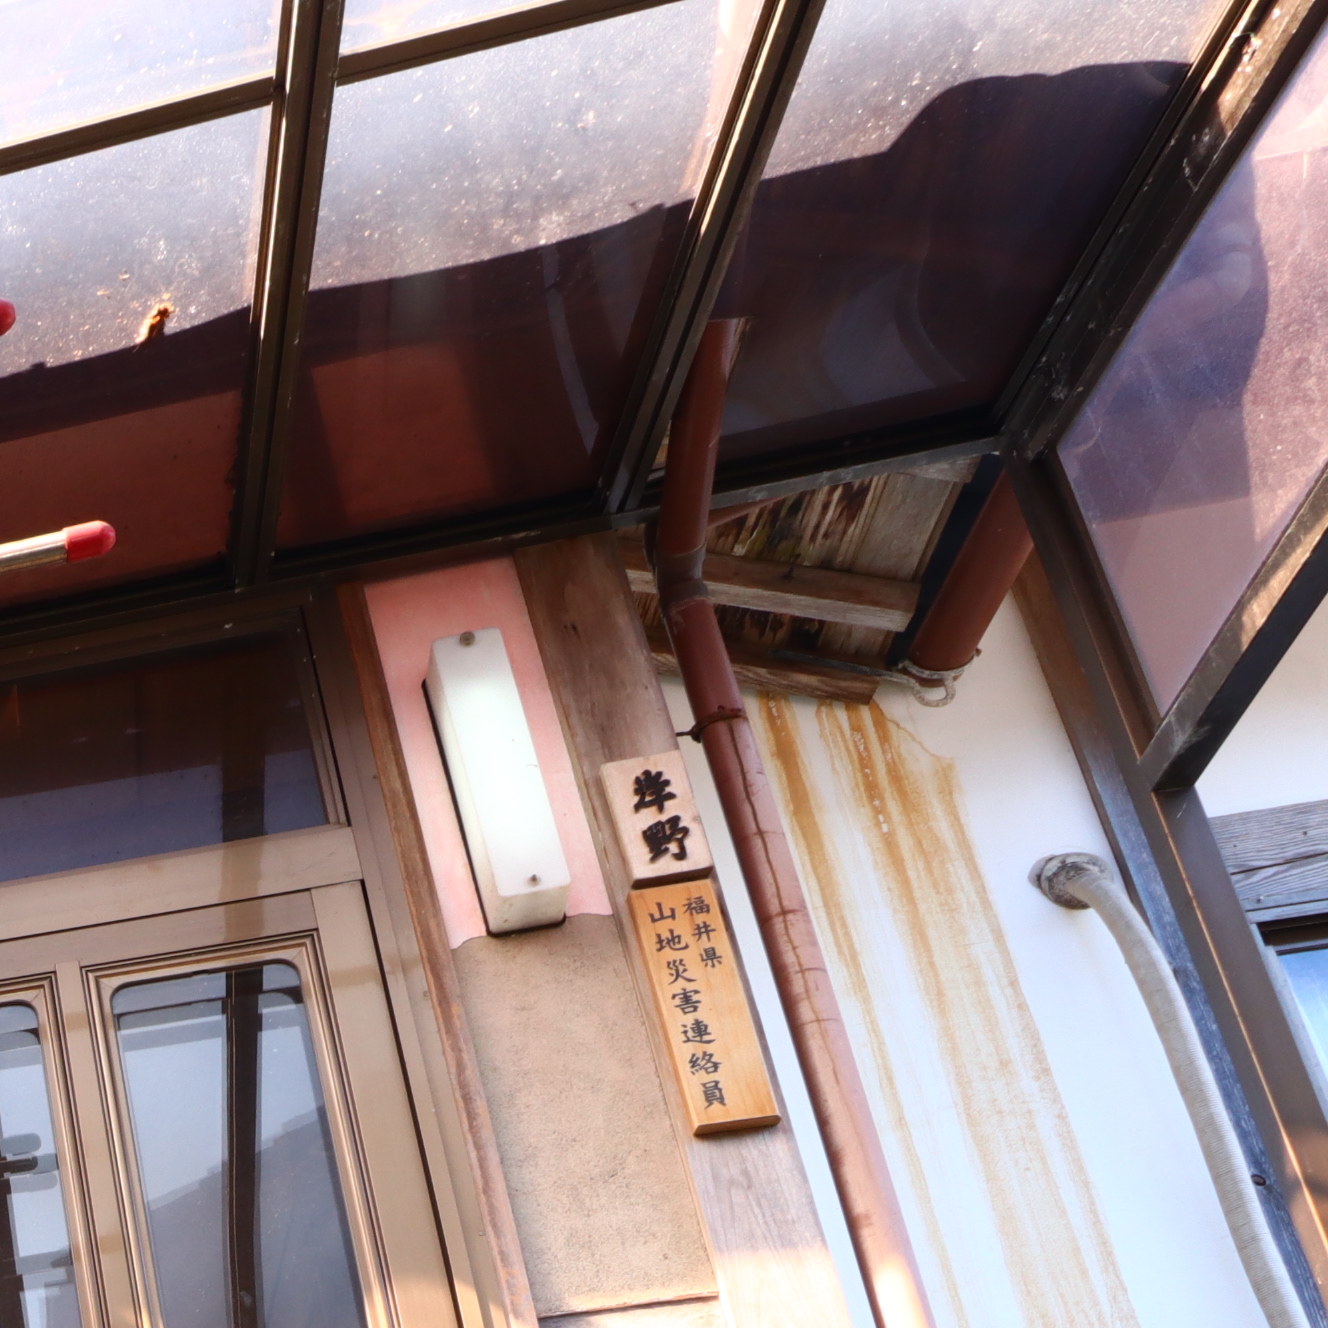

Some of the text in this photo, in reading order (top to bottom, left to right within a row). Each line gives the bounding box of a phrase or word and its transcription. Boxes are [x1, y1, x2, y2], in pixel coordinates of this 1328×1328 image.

[683, 897, 723, 969] 福井県
[649, 902, 727, 1109] 山地災害連絡員
